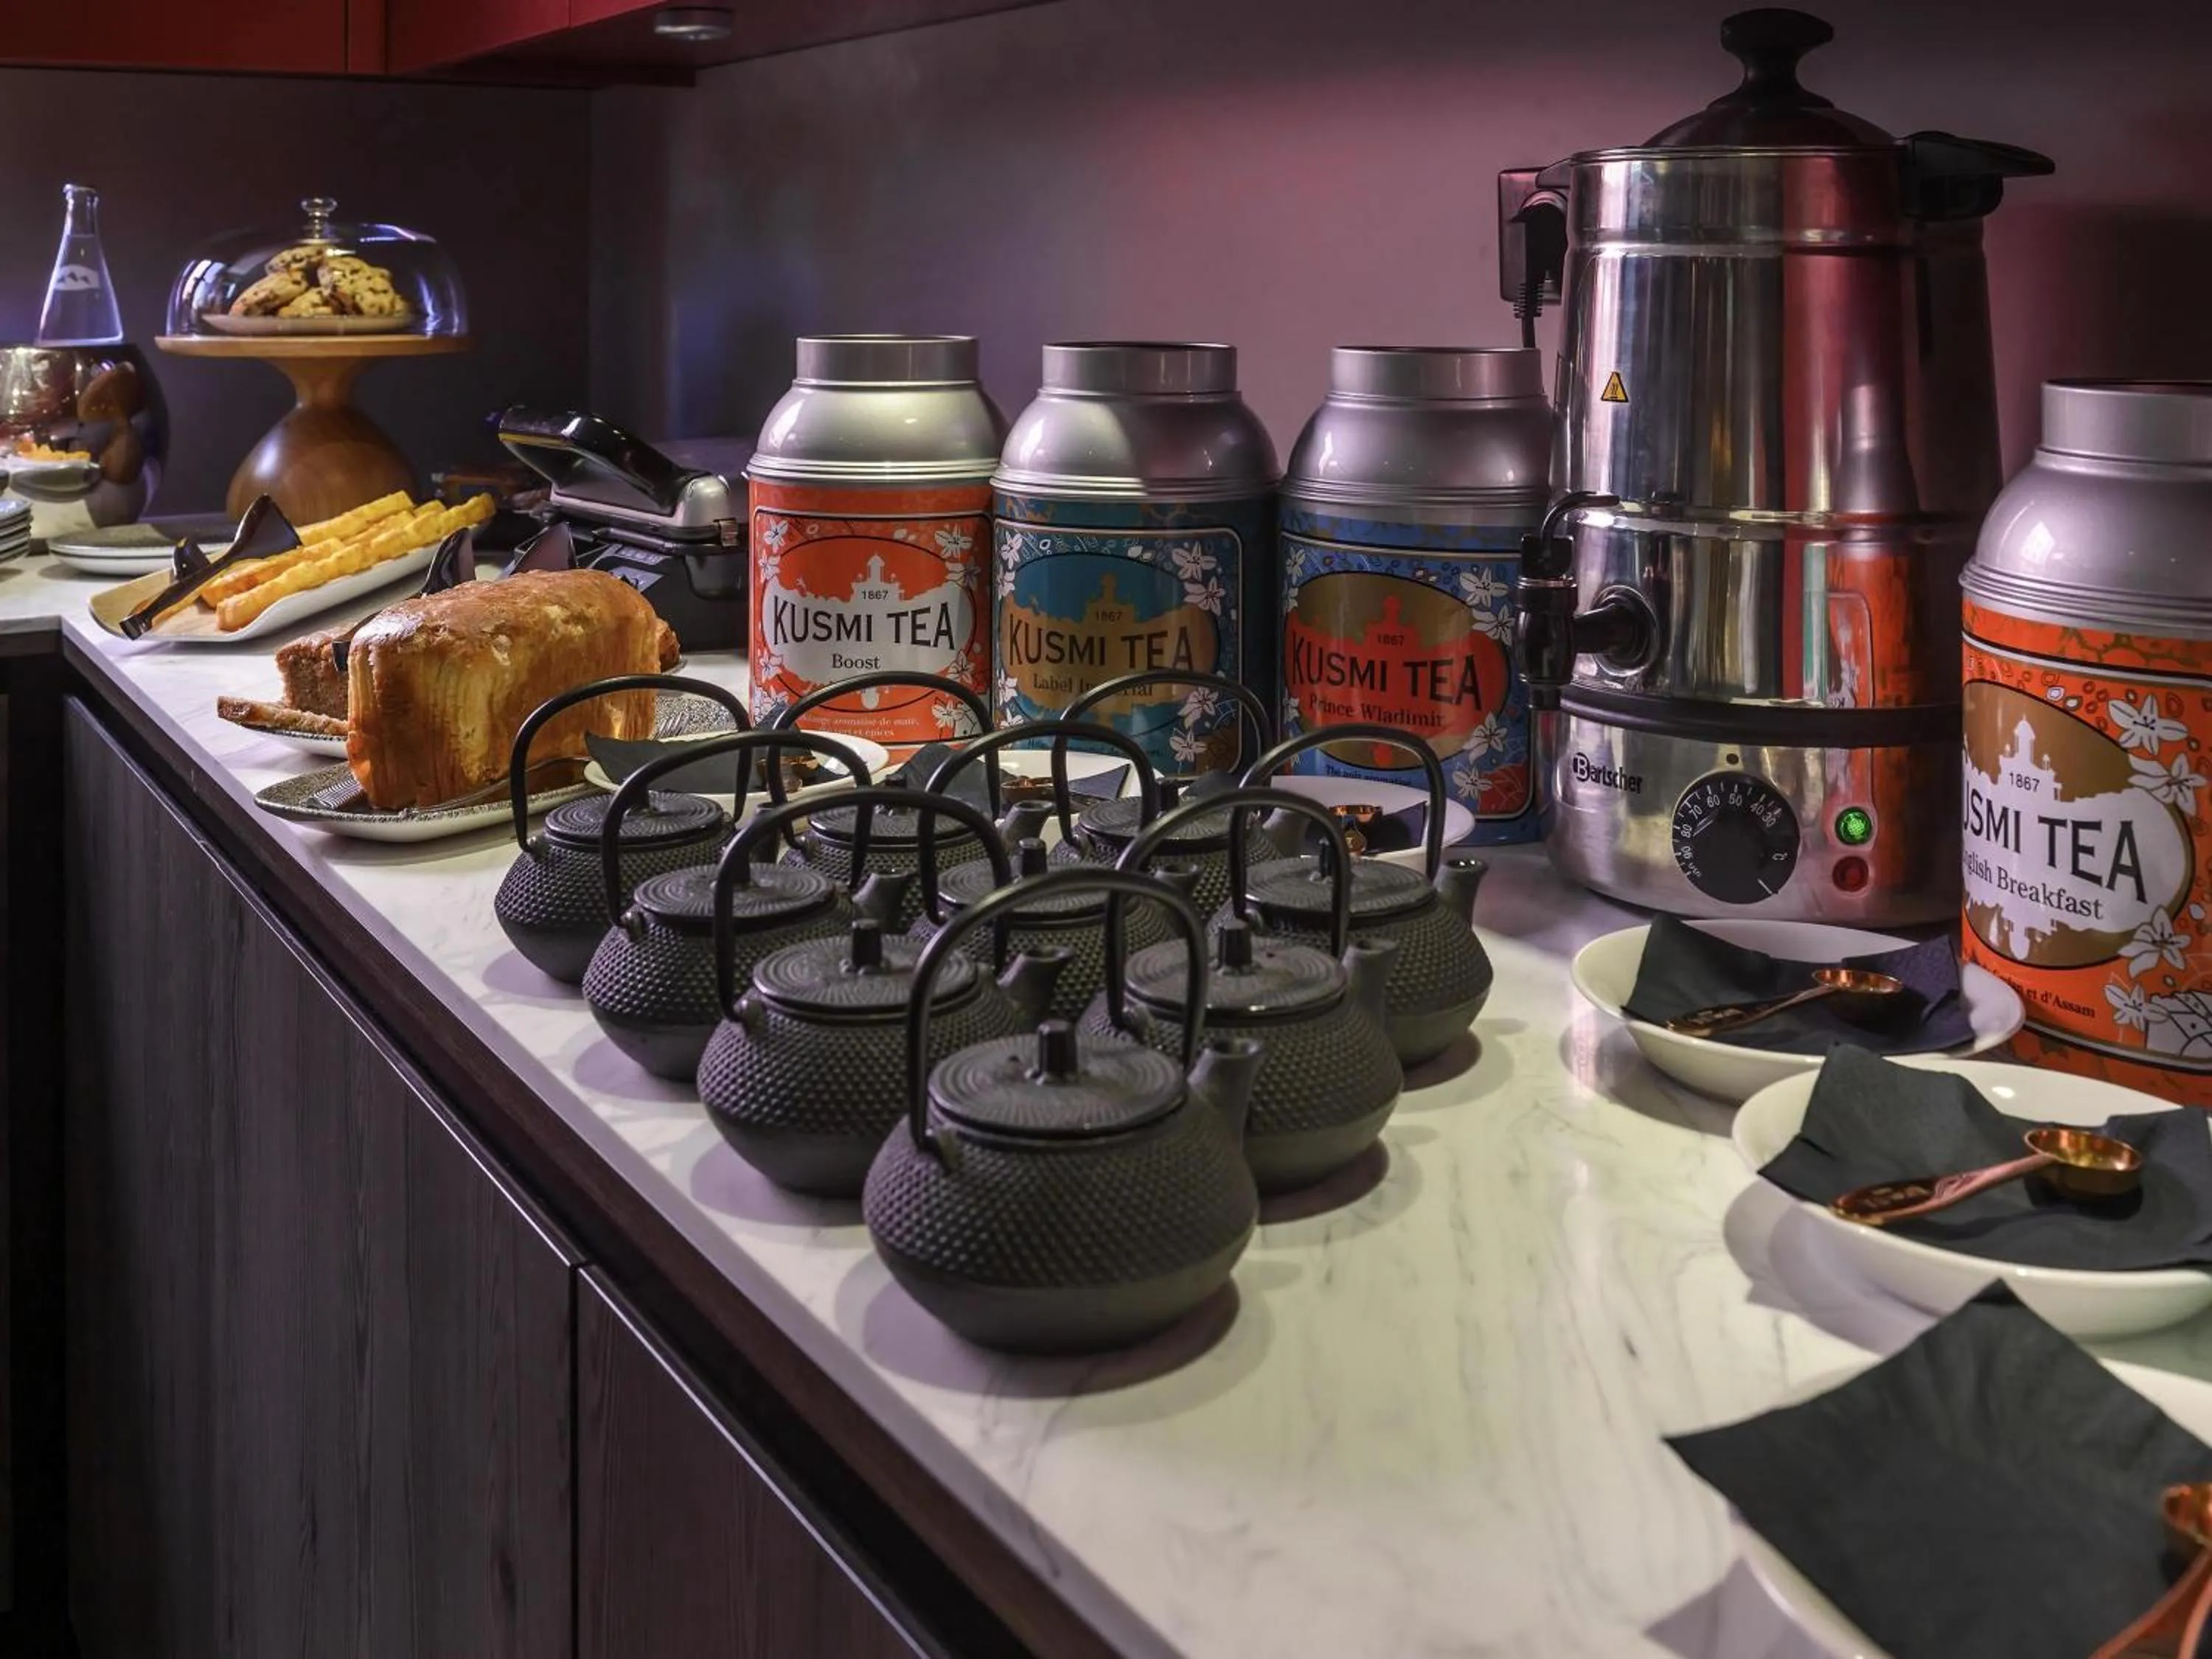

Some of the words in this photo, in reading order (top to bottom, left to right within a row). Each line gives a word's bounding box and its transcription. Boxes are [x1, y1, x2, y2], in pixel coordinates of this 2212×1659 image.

[861, 590, 888, 600] 1867
[773, 595, 873, 646] KUSMI
[886, 601, 956, 650] TEA
[1096, 611, 1124, 622] 1867
[1009, 613, 1106, 667] KUSMI
[1120, 625, 1194, 671] TEA
[1377, 633, 1405, 647] 1867
[832, 653, 880, 669] Boost
[1292, 630, 1388, 692] KUSMI
[1402, 653, 1482, 711] TEA
[1033, 673, 1073, 693] Label
[1310, 692, 1354, 718] Prince
[1361, 703, 1444, 728] Wladimir
[1572, 751, 1643, 794] Bartscher
[2008, 772, 2041, 793] 1867
[1706, 793, 1721, 808] 60
[1728, 792, 1743, 807] 50
[1688, 804, 1703, 820] 70
[1761, 812, 1776, 828] 30
[1680, 823, 1693, 838] 80
[2037, 814, 2149, 905] TEA
[1996, 864, 2104, 920] Breakfast
[2039, 991, 2096, 1018] d'Assam
